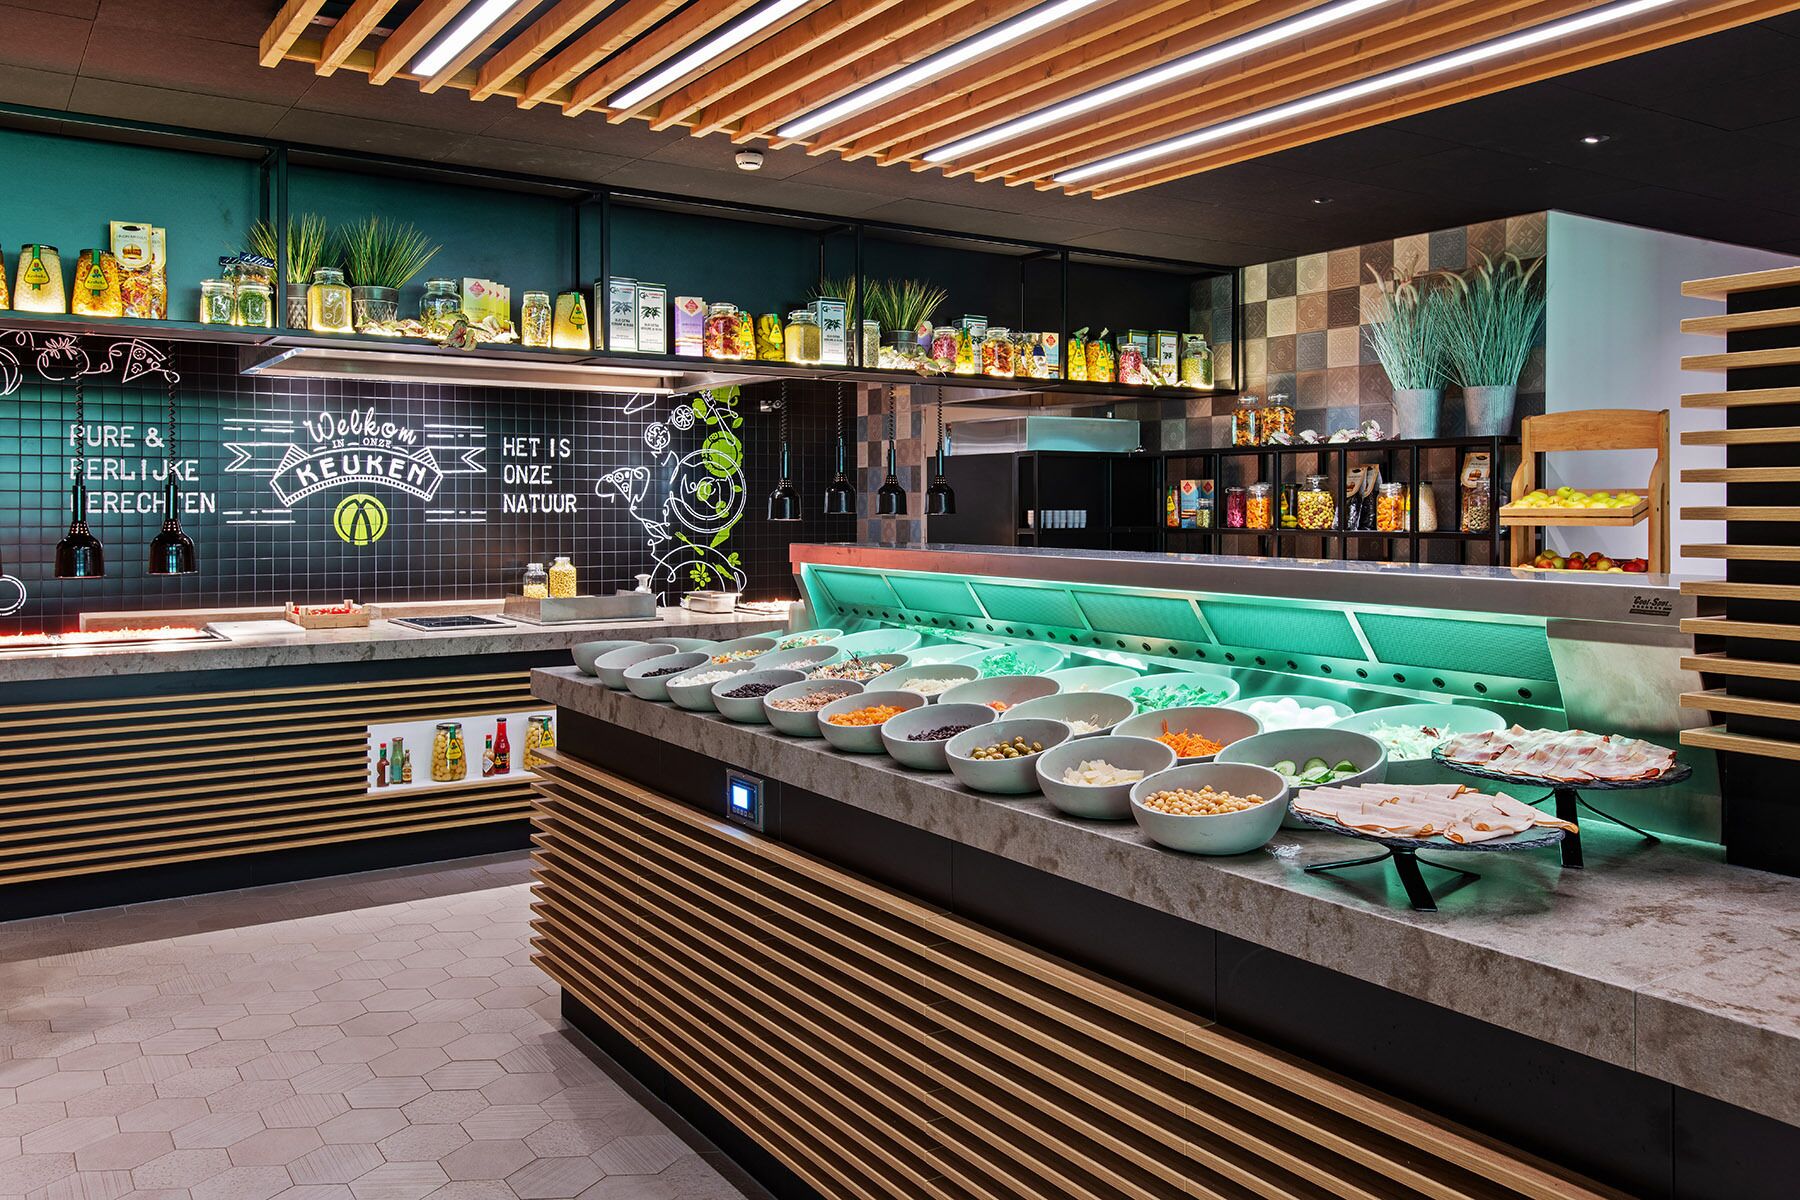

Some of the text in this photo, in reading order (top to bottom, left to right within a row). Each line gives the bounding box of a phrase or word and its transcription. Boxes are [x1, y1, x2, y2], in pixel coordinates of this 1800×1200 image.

[69, 423, 165, 448] PURE &
[302, 406, 417, 445] Welkom
[332, 437, 393, 449] IN ONZE
[502, 437, 571, 459] HET IS
[69, 457, 200, 481] EERLIJKE
[295, 454, 427, 487] KEUKEN
[502, 465, 553, 485] ONZE
[69, 490, 216, 514] ERECHEN
[502, 492, 578, 514] NATUUR
